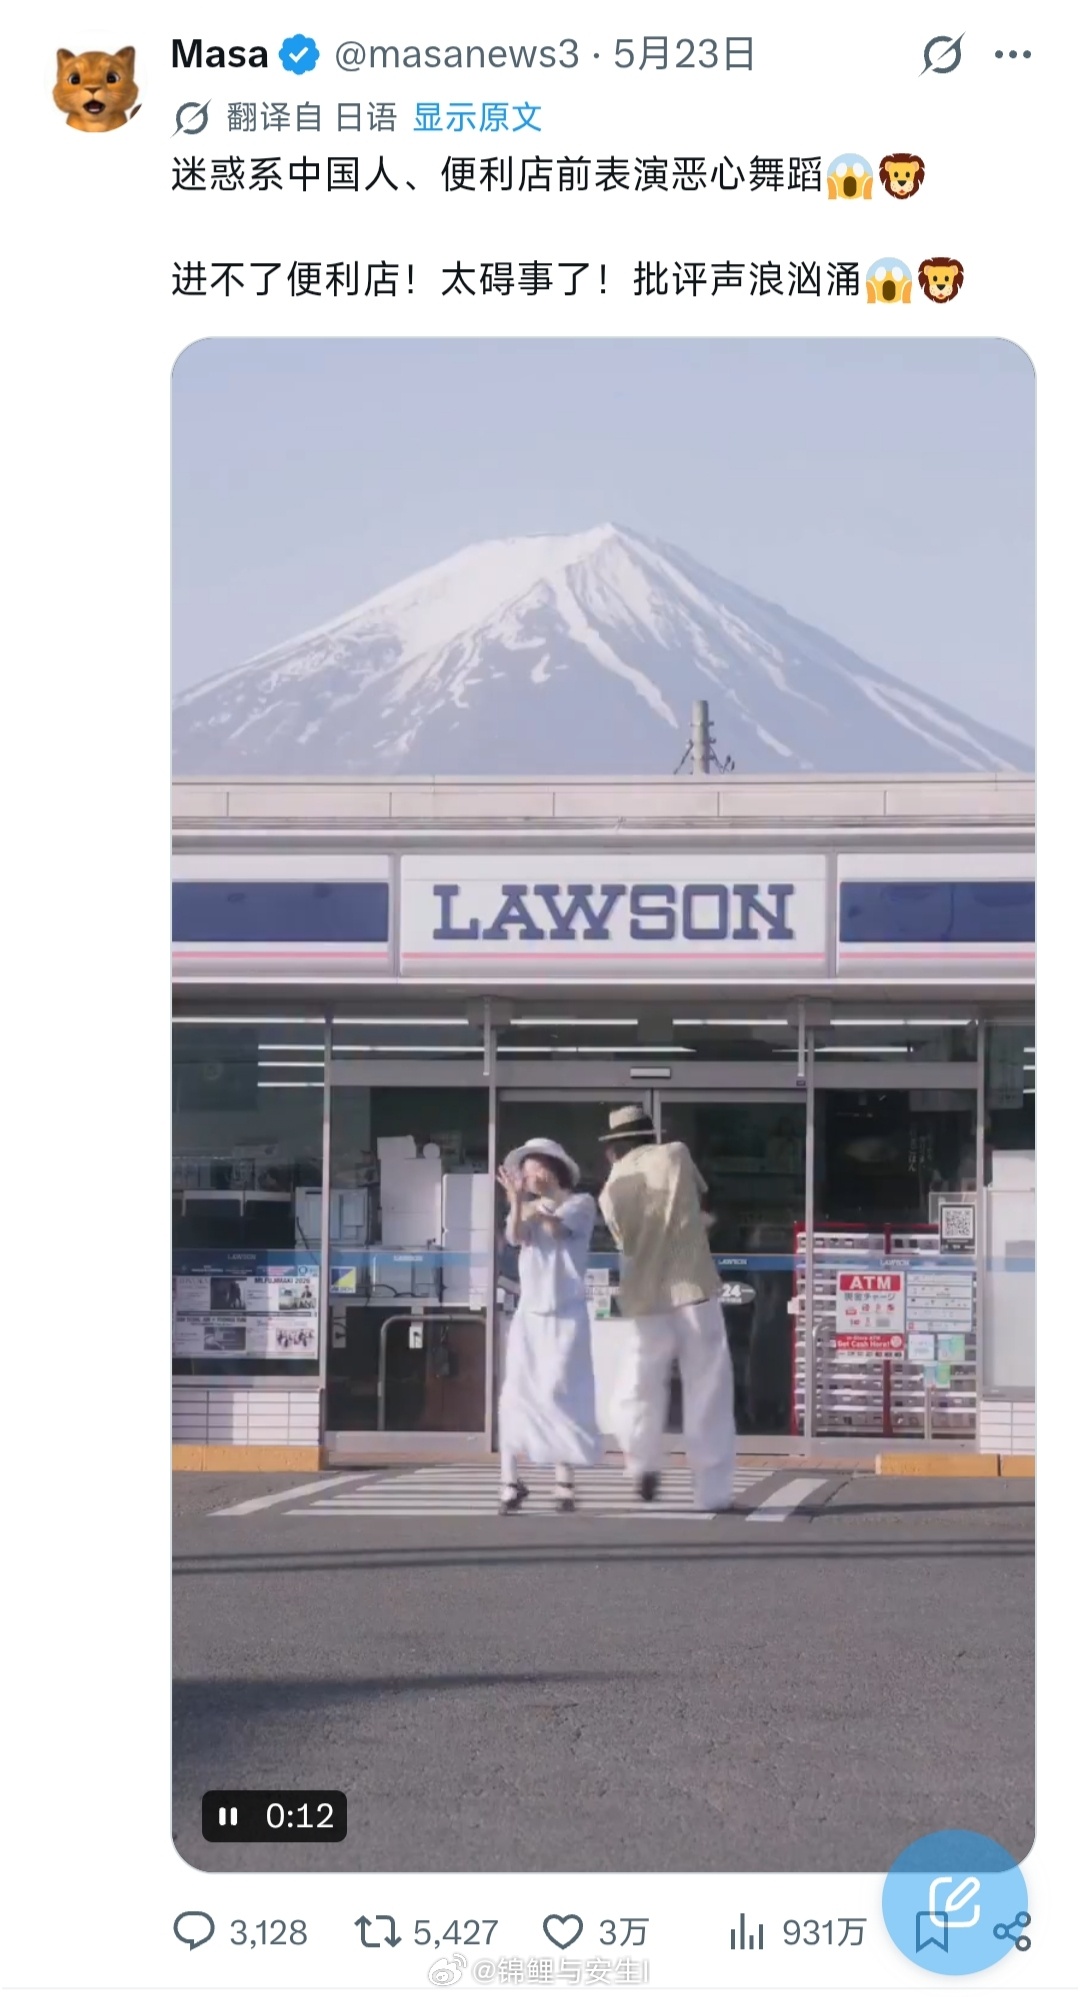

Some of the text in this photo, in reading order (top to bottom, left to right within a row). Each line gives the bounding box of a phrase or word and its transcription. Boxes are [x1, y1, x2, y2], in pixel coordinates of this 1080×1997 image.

[172, 36, 753, 72] Masa @masanews3 5月23日
[227, 101, 542, 132] 翻译自 日语 显示原文
[172, 154, 824, 193] 迷惑系中国人、便利店前表演恶心舞蹈
[433, 884, 794, 940] LAWSON
[722, 1283, 742, 1297] 24
[849, 1275, 892, 1290] ATM
[266, 1802, 334, 1829] 0:12
[230, 1917, 868, 1950] 3,128 5,427 3万 931万
